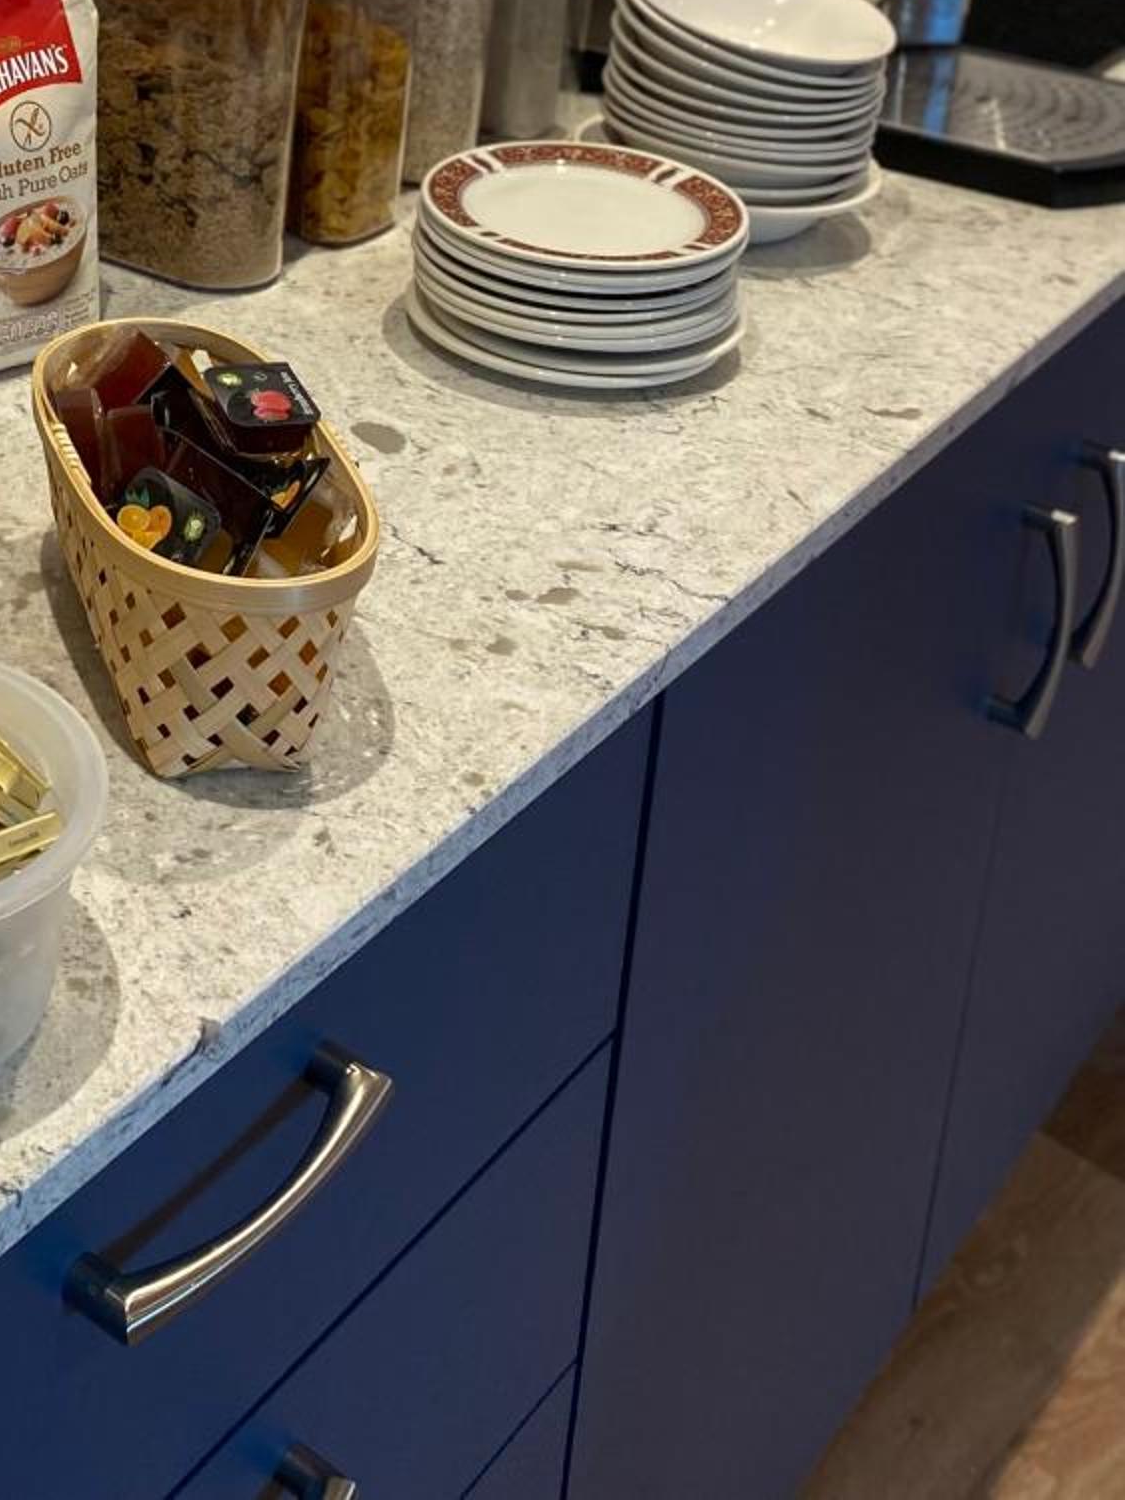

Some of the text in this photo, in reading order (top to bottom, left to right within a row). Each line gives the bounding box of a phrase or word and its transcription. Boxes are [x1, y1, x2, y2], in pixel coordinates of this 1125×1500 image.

[49, 142, 82, 165] Free
[18, 174, 58, 197] Pure
[59, 161, 88, 183] Oats
